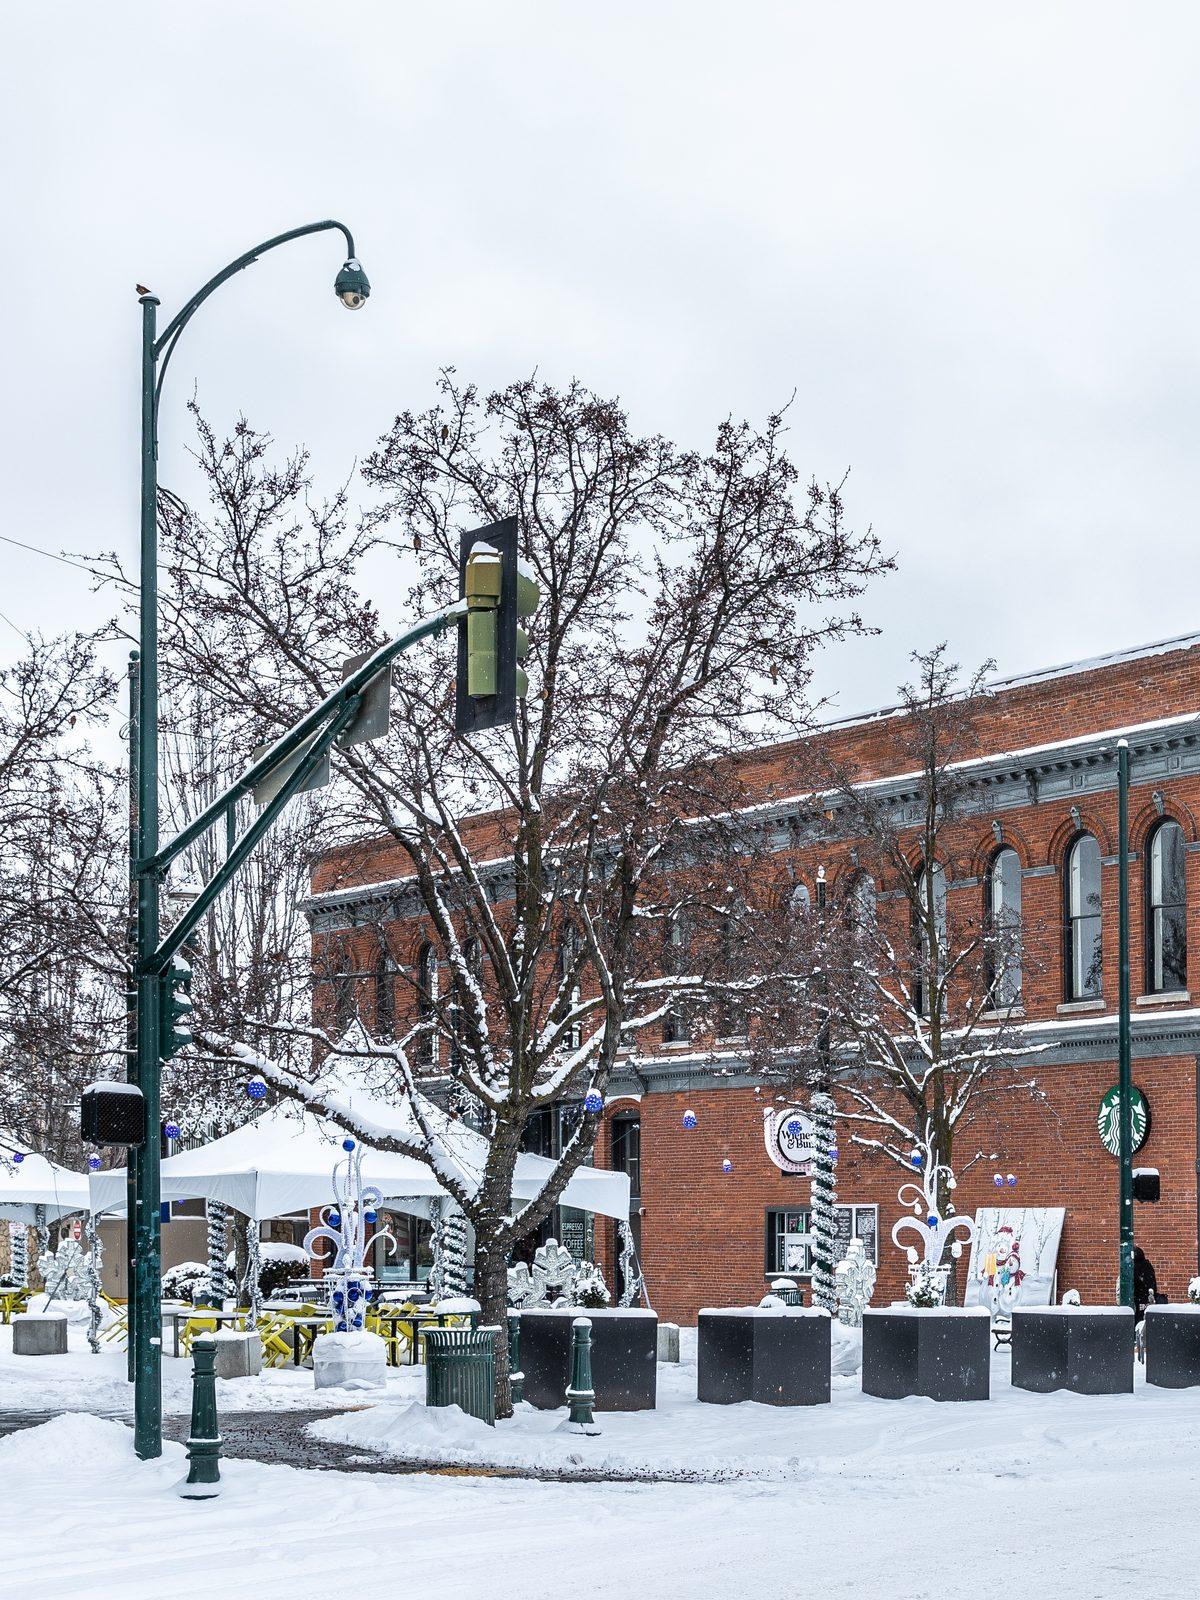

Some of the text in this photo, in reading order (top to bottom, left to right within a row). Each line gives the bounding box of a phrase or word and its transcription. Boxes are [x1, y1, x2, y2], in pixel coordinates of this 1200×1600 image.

[787, 1139, 795, 1149] &
[561, 1222, 584, 1231] ESPRESSO
[562, 1239, 584, 1249] COFFEE
